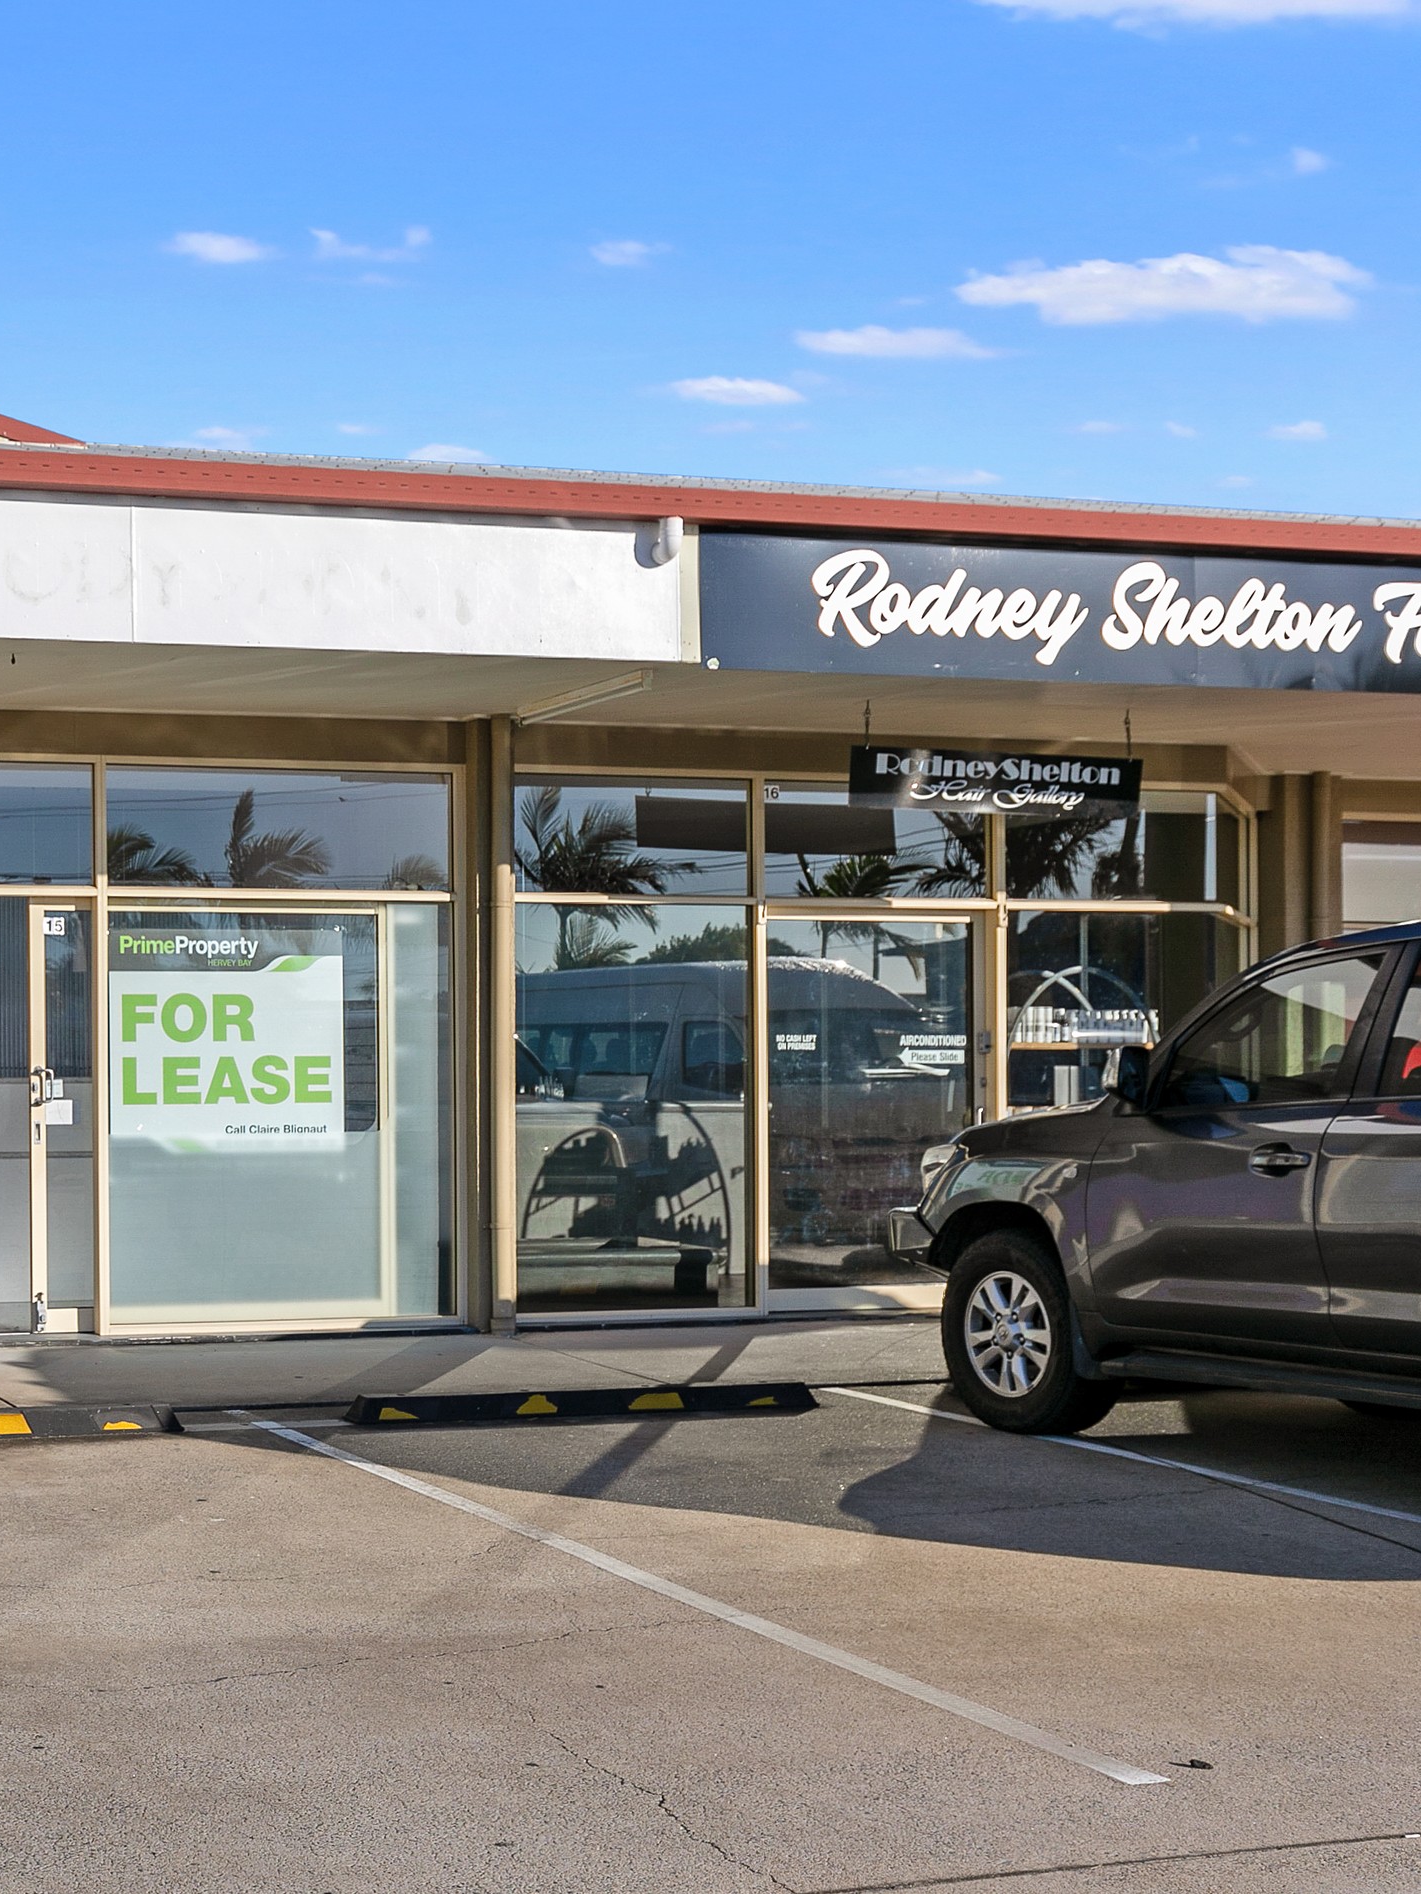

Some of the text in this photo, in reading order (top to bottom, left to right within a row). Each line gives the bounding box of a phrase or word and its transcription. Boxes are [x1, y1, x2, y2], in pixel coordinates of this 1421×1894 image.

[811, 549, 1088, 666] Rodney
[1101, 561, 1363, 655] Shelton
[764, 786, 780, 800] 16
[910, 780, 1085, 811] Hair Gallery
[46, 919, 63, 932] 15
[207, 959, 253, 967] HERVEY BAY
[121, 993, 256, 1043] FOR
[899, 1034, 967, 1047] AIRCONDITIONED
[911, 1052, 959, 1062] Please Slide
[122, 1055, 332, 1105] LEASE
[224, 1124, 246, 1134] Call
[248, 1124, 280, 1134] Claire
